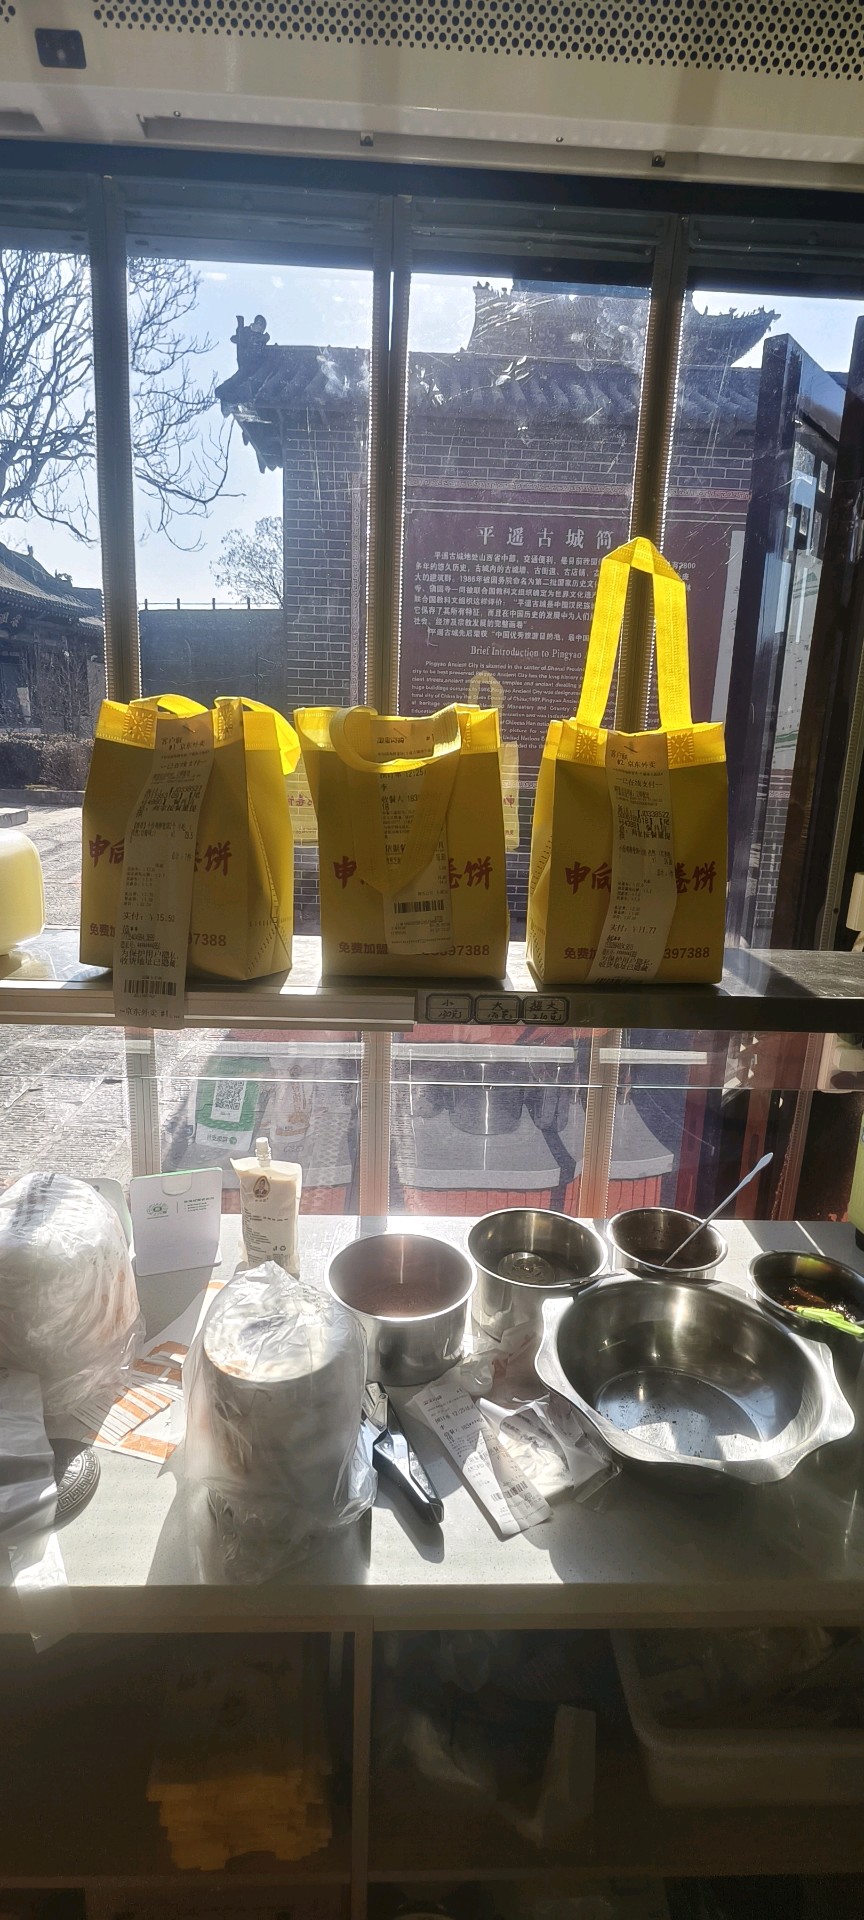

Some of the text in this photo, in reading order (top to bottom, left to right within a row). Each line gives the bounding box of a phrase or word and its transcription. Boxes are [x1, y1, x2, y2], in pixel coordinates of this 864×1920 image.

[477, 526, 614, 549] 平遥古城简
[470, 646, 582, 661] Brief Introduction to Pingyao
[339, 942, 388, 955] 免费加盟
[491, 1001, 503, 1010] 大
